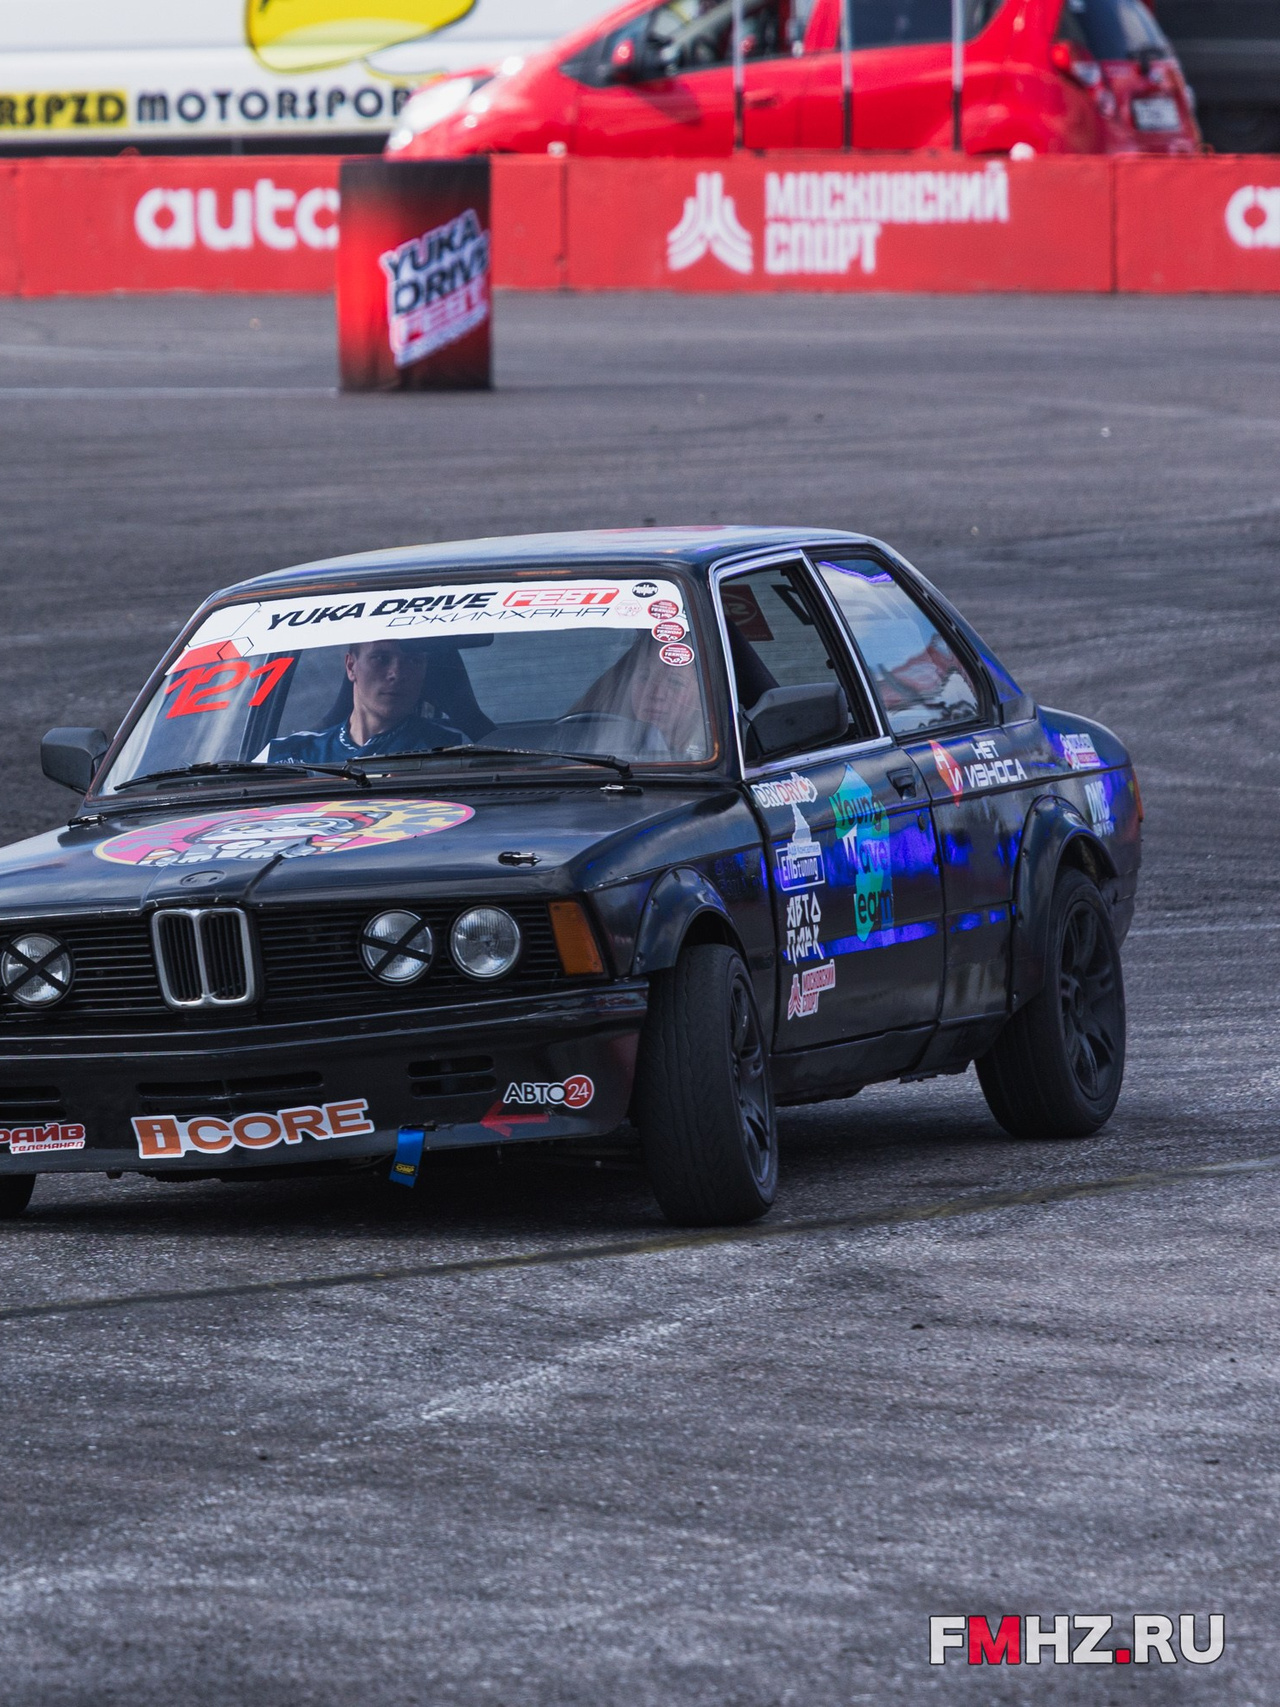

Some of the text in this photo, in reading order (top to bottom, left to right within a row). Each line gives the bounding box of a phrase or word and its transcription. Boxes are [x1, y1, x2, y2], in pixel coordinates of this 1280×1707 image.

[765, 162, 1009, 224] МОСКОВСКИЙ
[385, 216, 477, 281] YUKA
[765, 220, 882, 274] СПОРТ
[268, 602, 366, 630] YUKA
[369, 591, 498, 617] DRIVE
[505, 588, 619, 608] FEST
[164, 657, 295, 720] 121
[972, 740, 1000, 760] НЕТ
[831, 792, 884, 832] Young
